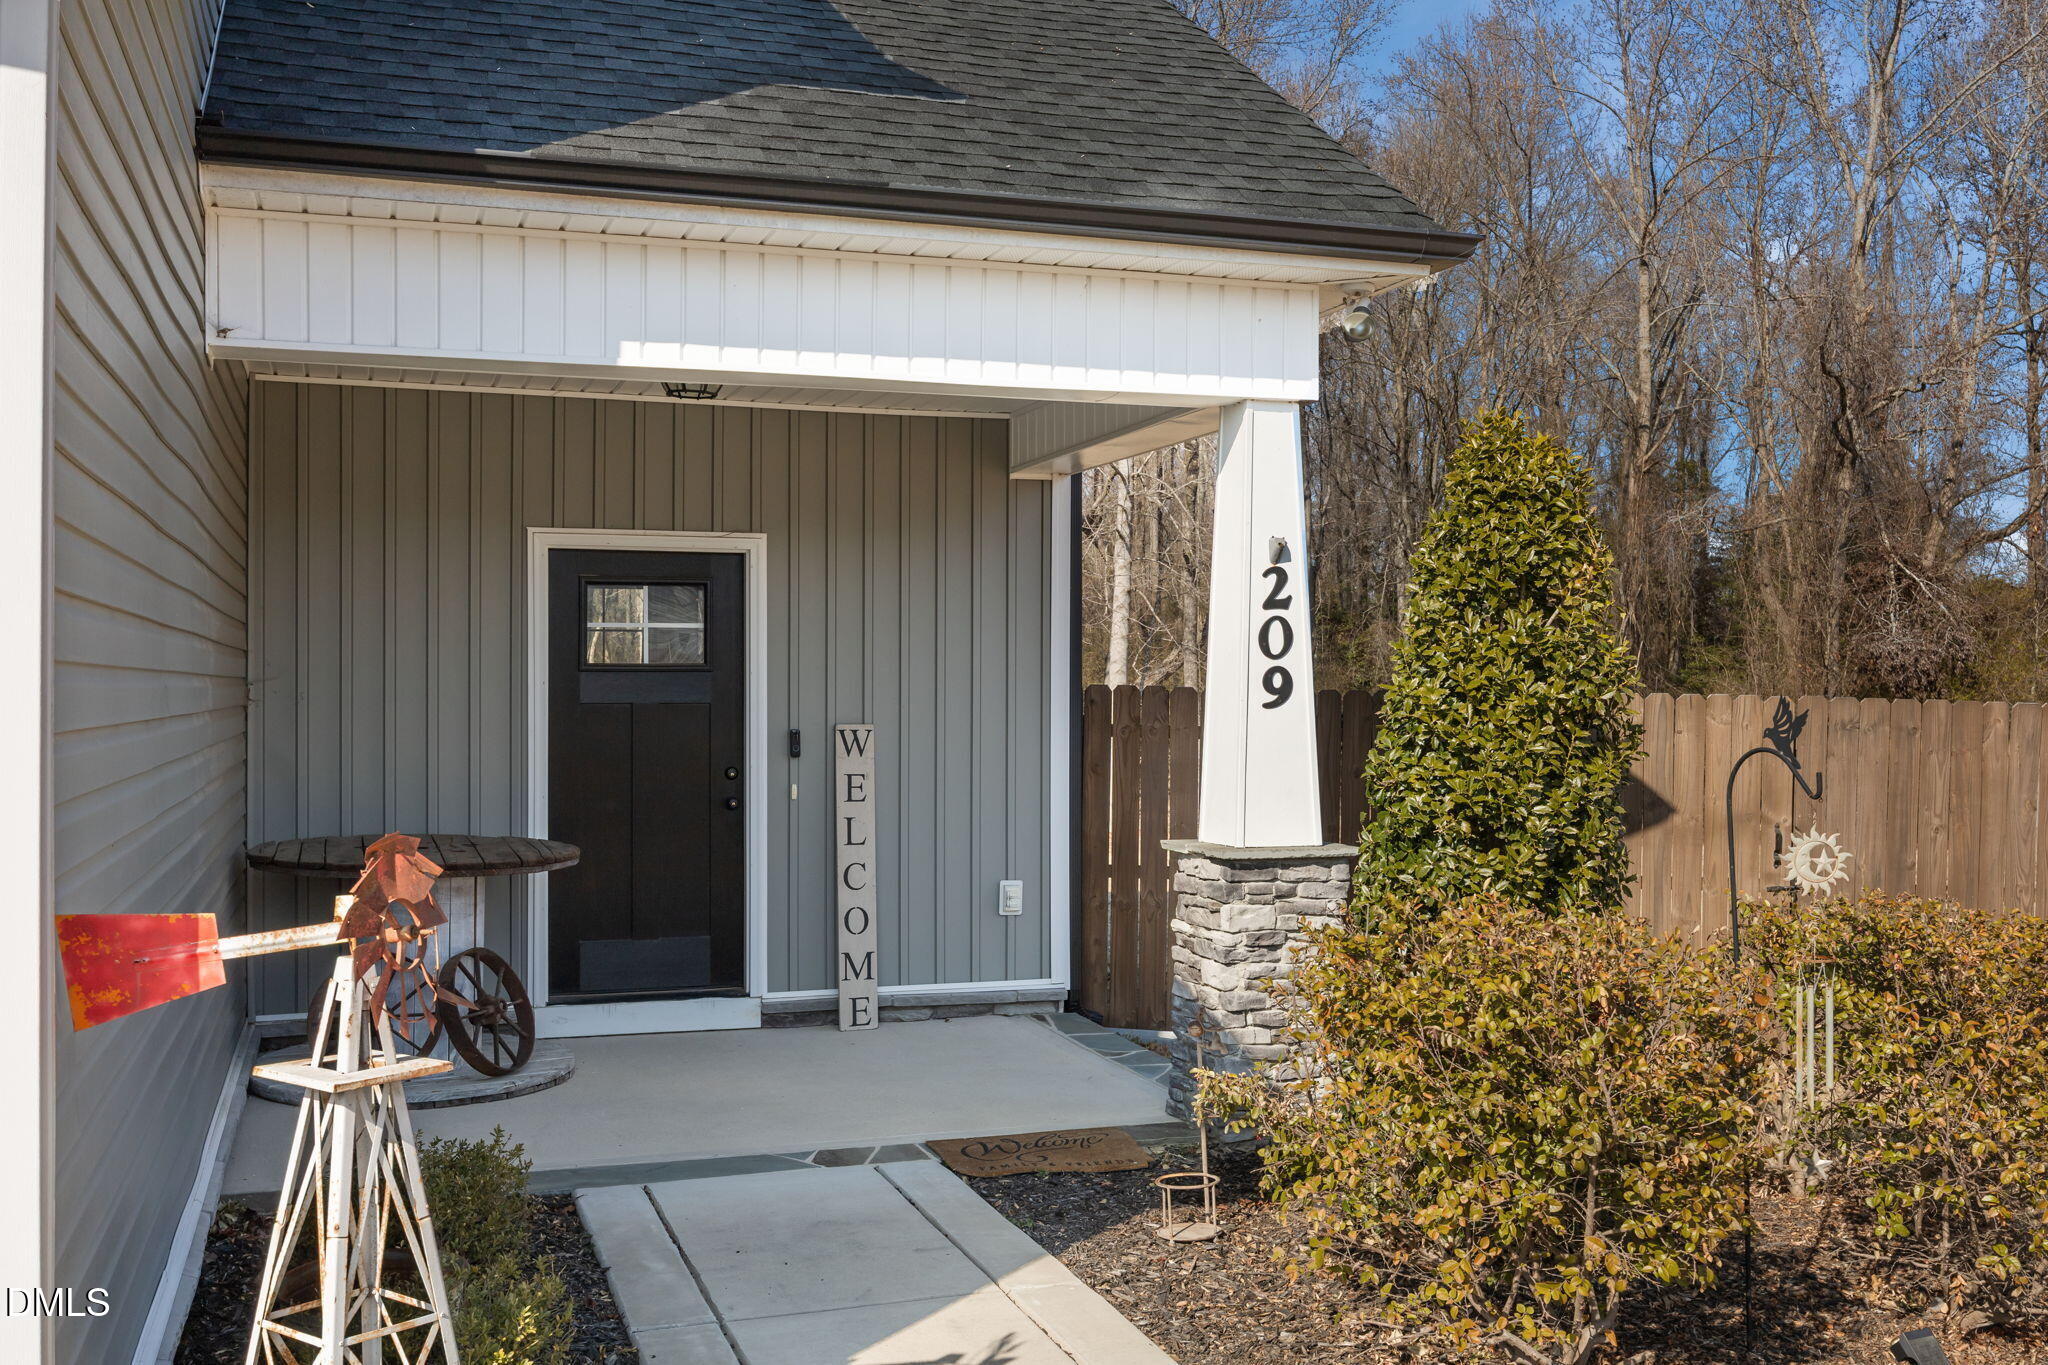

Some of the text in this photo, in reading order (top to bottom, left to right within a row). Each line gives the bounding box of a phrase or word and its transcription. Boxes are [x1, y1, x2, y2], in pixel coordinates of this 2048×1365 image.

[1258, 566, 1294, 709] 209
[837, 729, 875, 1026] WELCOME
[961, 1133, 1109, 1162] Welcome
